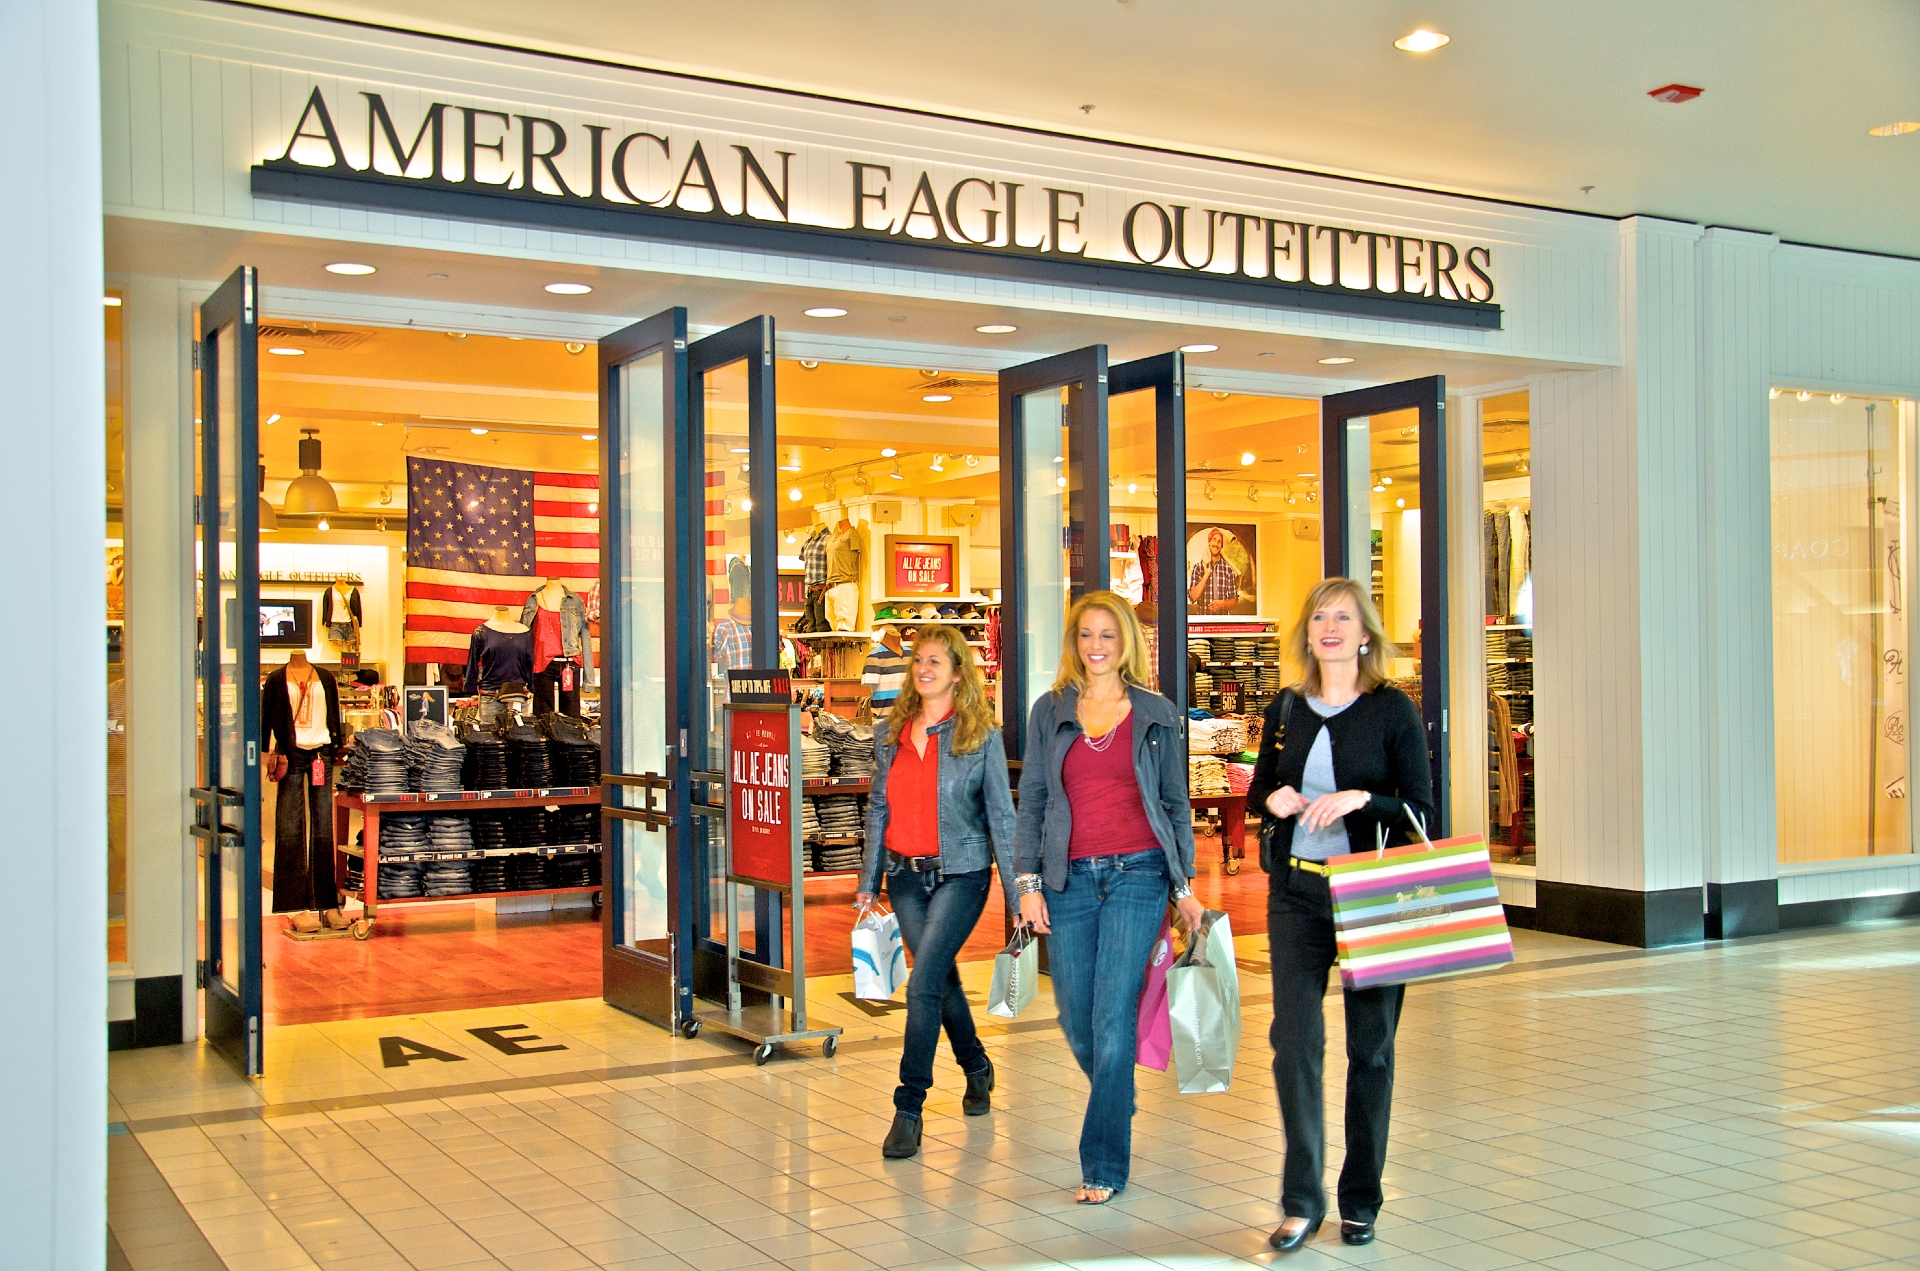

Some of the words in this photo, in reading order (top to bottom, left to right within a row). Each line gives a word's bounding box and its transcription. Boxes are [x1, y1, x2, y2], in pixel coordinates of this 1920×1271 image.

[283, 85, 797, 222] AMERICAN
[846, 161, 1088, 257] EAGLE
[1123, 201, 1494, 303] OUTFITTERS
[902, 557, 913, 570] ALL
[914, 557, 922, 570] AE
[923, 557, 942, 571] JEANS
[907, 570, 917, 583] ON
[919, 570, 936, 583] SALE
[778, 581, 805, 603] SAL
[772, 677, 790, 695] SALE
[733, 750, 748, 784] ALL
[749, 751, 761, 786] AE
[761, 752, 789, 789] JEANS
[741, 788, 754, 821] ON
[757, 789, 782, 825] SALE
[378, 1024, 570, 1068] AE
